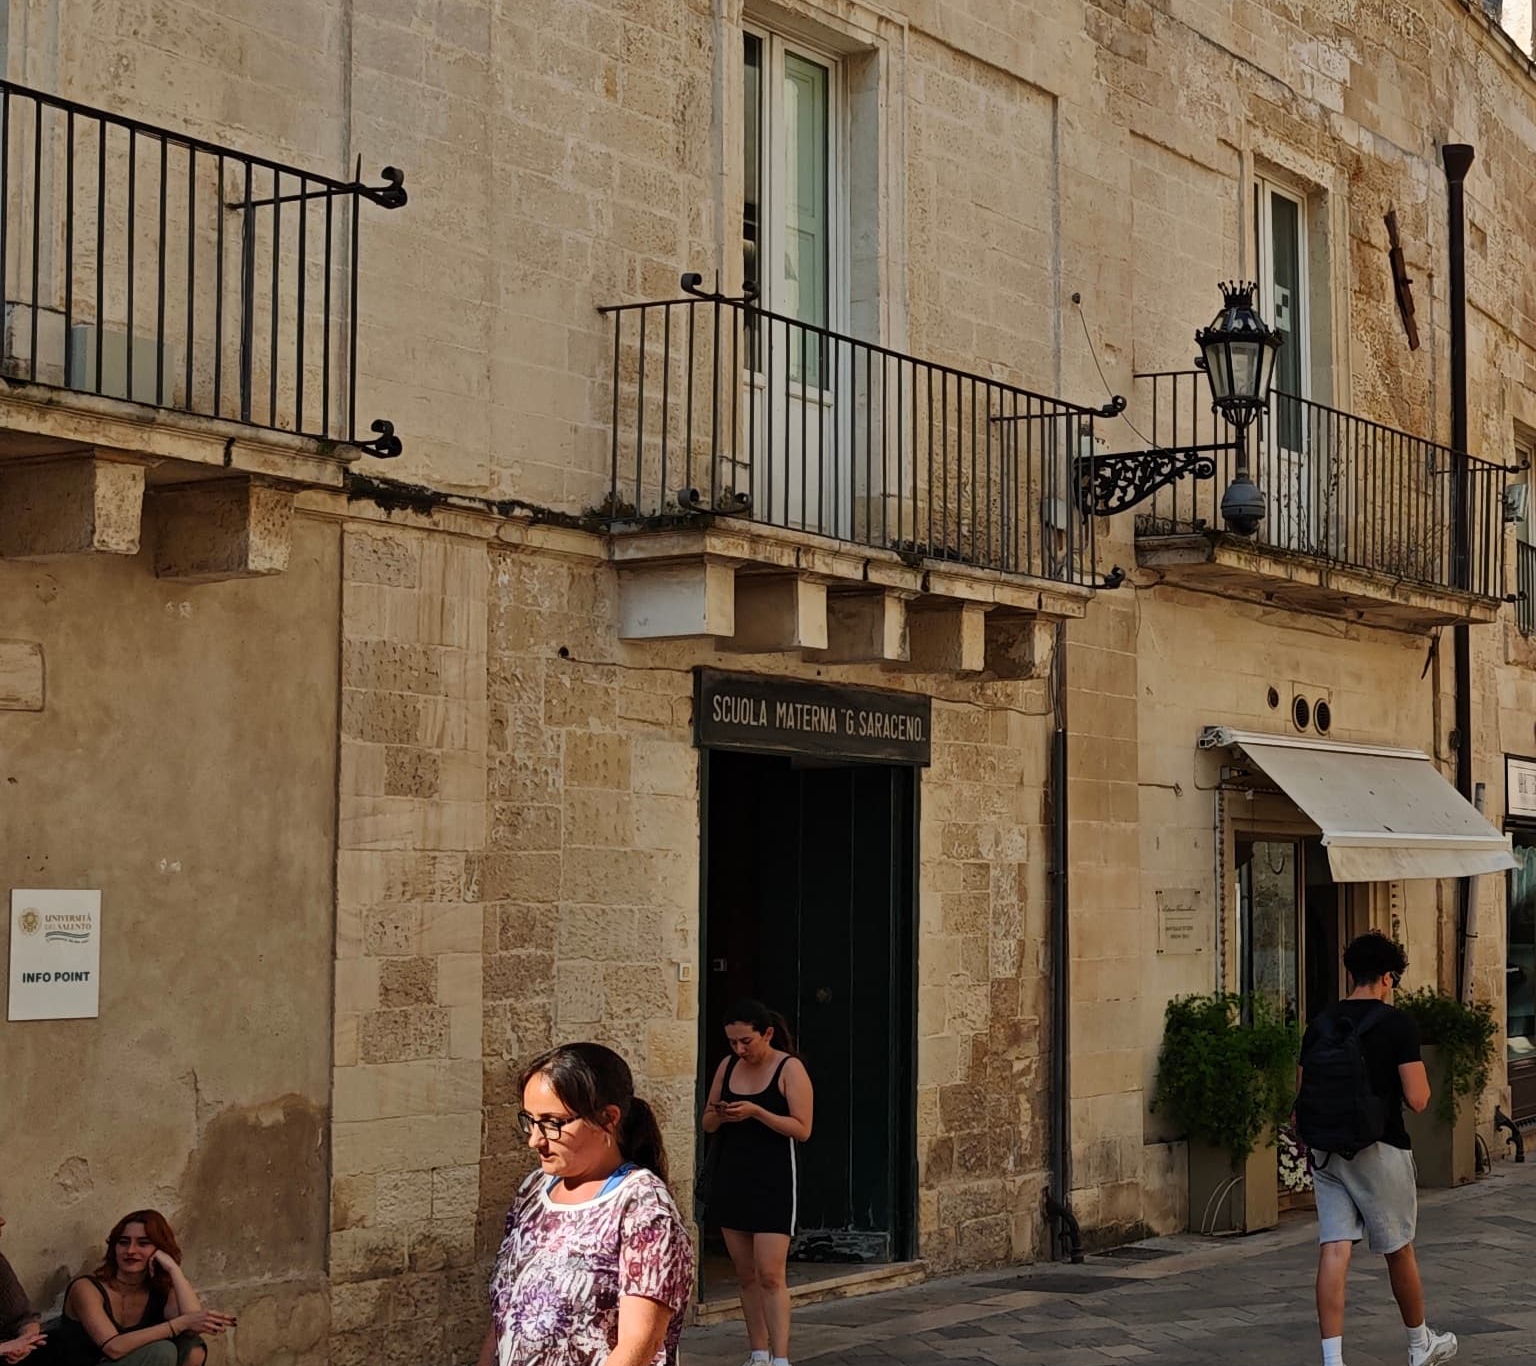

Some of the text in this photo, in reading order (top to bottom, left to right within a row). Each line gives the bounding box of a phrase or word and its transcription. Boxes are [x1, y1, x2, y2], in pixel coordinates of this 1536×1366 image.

[712, 694, 767, 727] SCUOLA
[775, 701, 837, 734] MATERNA
[45, 913, 92, 922] UNIVERSITÀ
[57, 923, 91, 931] SALENTO
[22, 971, 91, 983] INFO POINT
